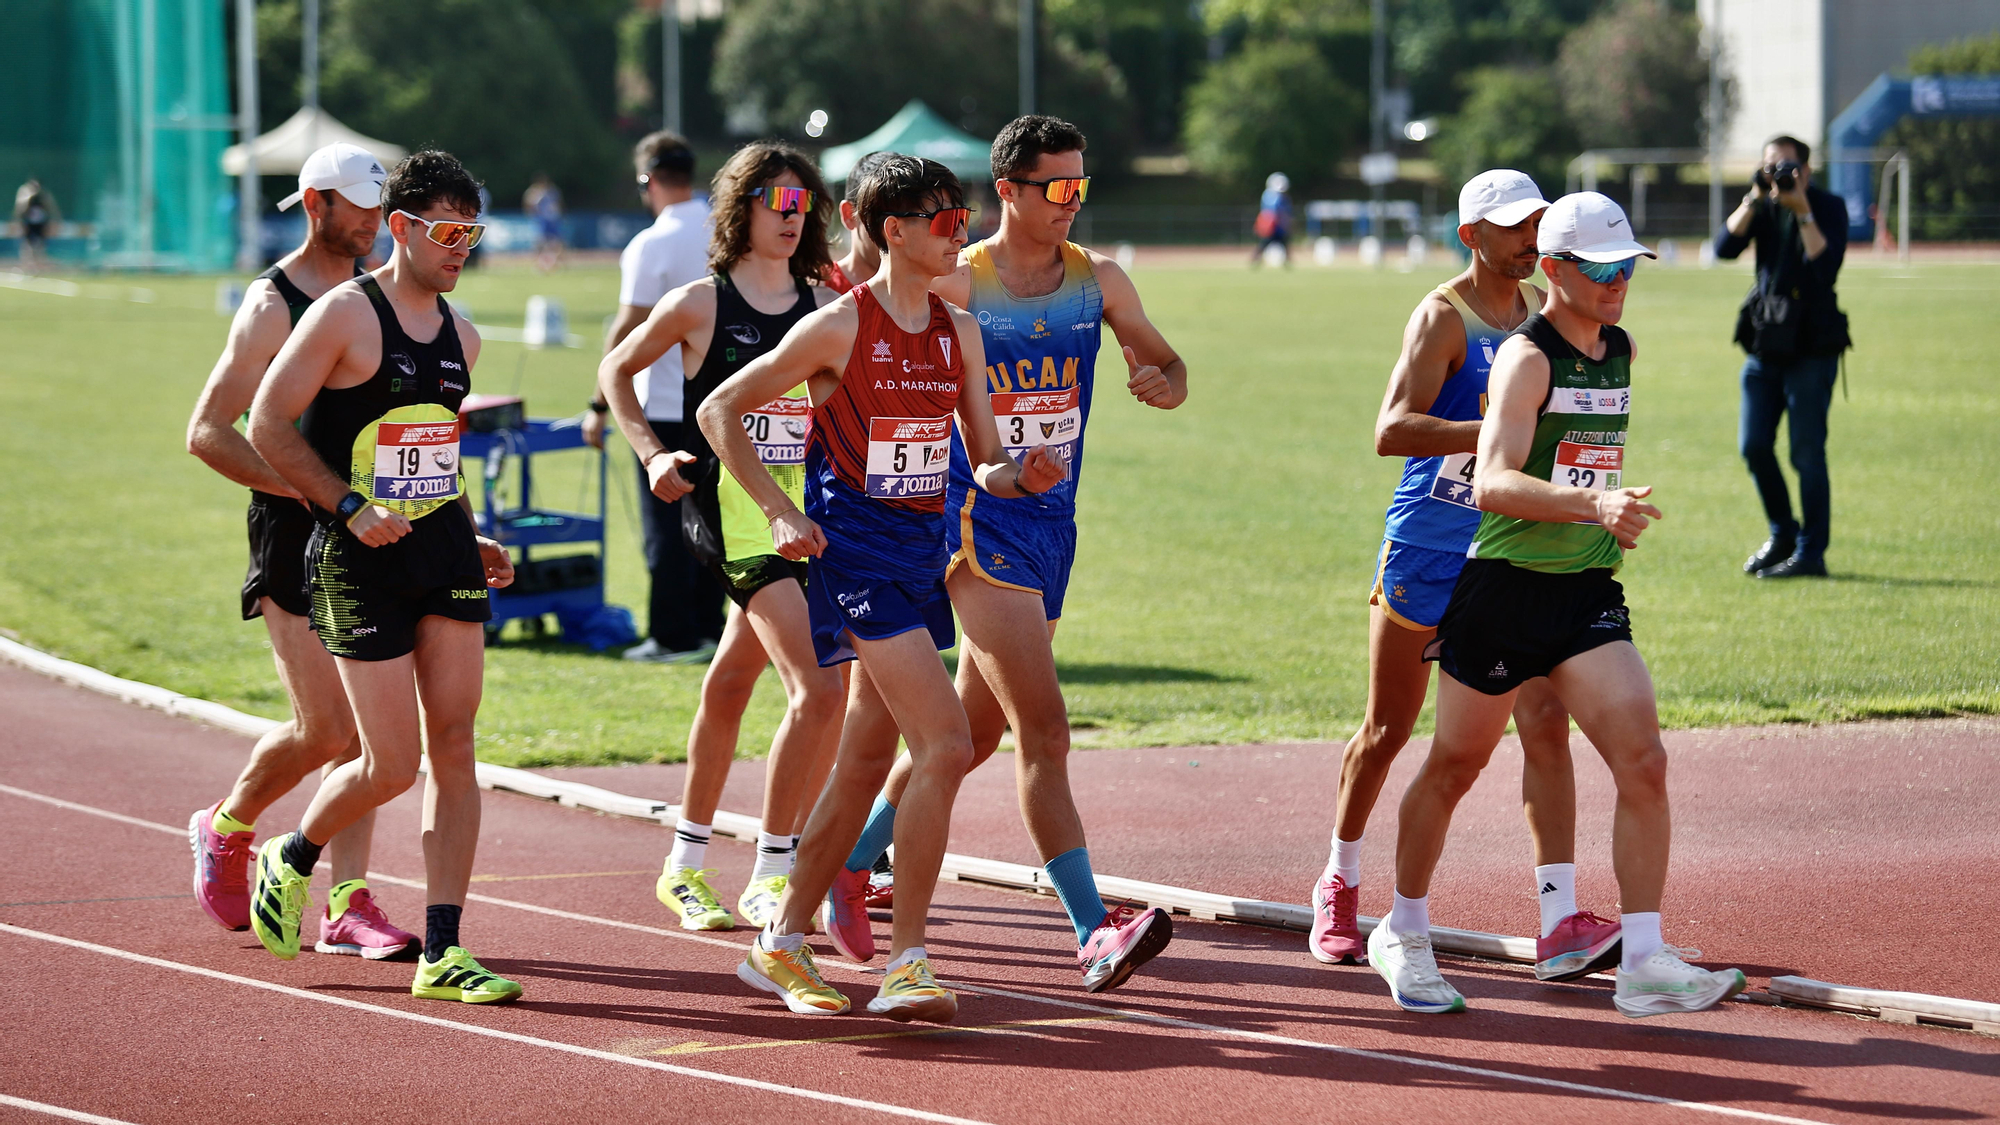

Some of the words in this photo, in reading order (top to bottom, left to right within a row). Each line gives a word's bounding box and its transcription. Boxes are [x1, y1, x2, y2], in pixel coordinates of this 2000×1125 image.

[992, 315, 1012, 323] Costa
[992, 323, 1015, 331] Cálida
[1030, 331, 1051, 340] KELME
[871, 355, 894, 363] luanvi
[986, 356, 1080, 393] UCAM
[874, 380, 898, 390] A.D.
[901, 380, 957, 393] MARATHON
[1037, 393, 1071, 406] RFEA
[743, 414, 770, 442] 20
[917, 420, 947, 434] RFEA
[1010, 416, 1024, 445] 3
[1058, 417, 1075, 429] UCAM
[422, 425, 455, 438] RFEA
[893, 443, 908, 473] 5
[930, 445, 949, 461] ADM
[397, 447, 420, 476] 19
[1459, 455, 1477, 483] 4
[1568, 467, 1596, 488] 32
[847, 600, 871, 618] DM
